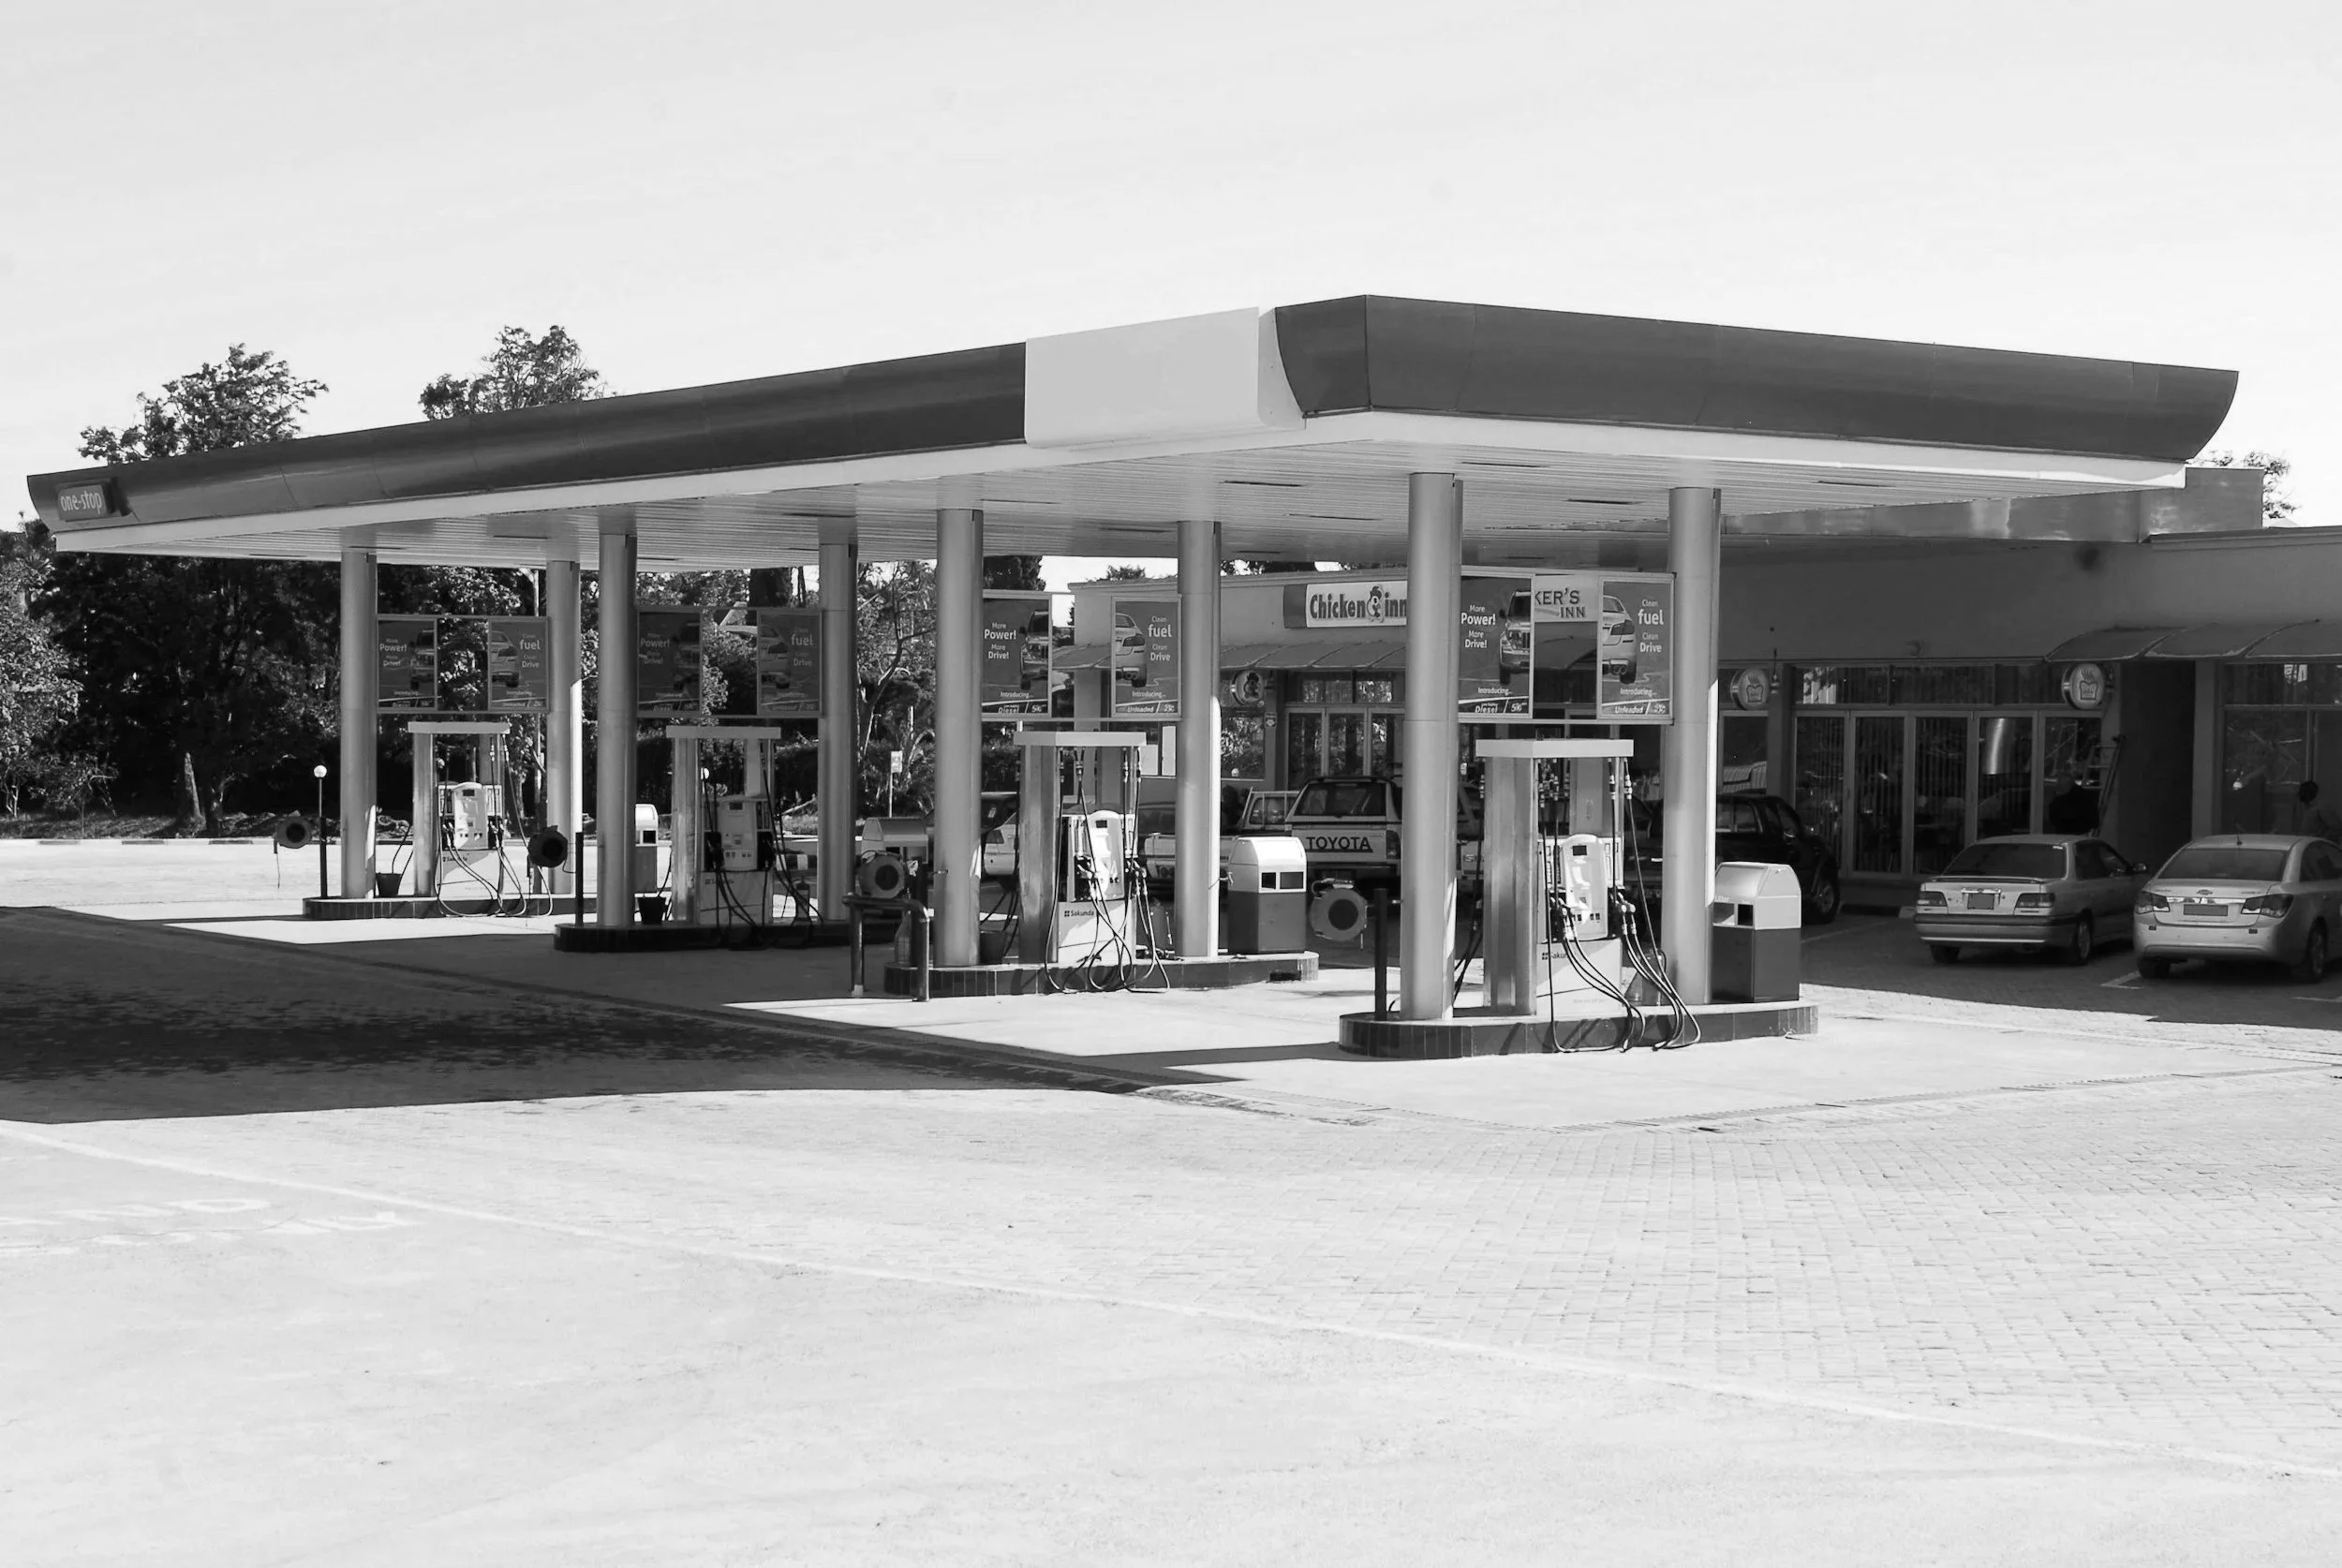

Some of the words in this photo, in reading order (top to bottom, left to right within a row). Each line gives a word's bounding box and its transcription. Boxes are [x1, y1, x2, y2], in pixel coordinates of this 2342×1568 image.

[60, 490, 102, 514] one-stop
[1310, 593, 1366, 619] Chicken
[1641, 599, 1658, 608] Clean
[1469, 604, 1486, 614] More
[1560, 606, 1586, 618] INN
[1460, 613, 1496, 626] Power!
[1638, 609, 1664, 626] fuel
[984, 629, 1016, 640] Power!
[1148, 625, 1172, 638] fuel
[1468, 629, 1485, 639] More
[791, 633, 813, 646] fuel
[1641, 632, 1659, 642] Clean
[379, 643, 407, 652] Power!
[520, 639, 541, 650] fuel
[640, 638, 671, 648] Power!
[1464, 639, 1488, 649] Drive!
[1639, 643, 1662, 653] Drive
[987, 651, 1010, 659] Drive!
[1149, 652, 1171, 661] Drive
[793, 658, 812, 666] Drive
[1306, 836, 1371, 851] TOYOTA
[1071, 909, 1094, 917] Sakunda
